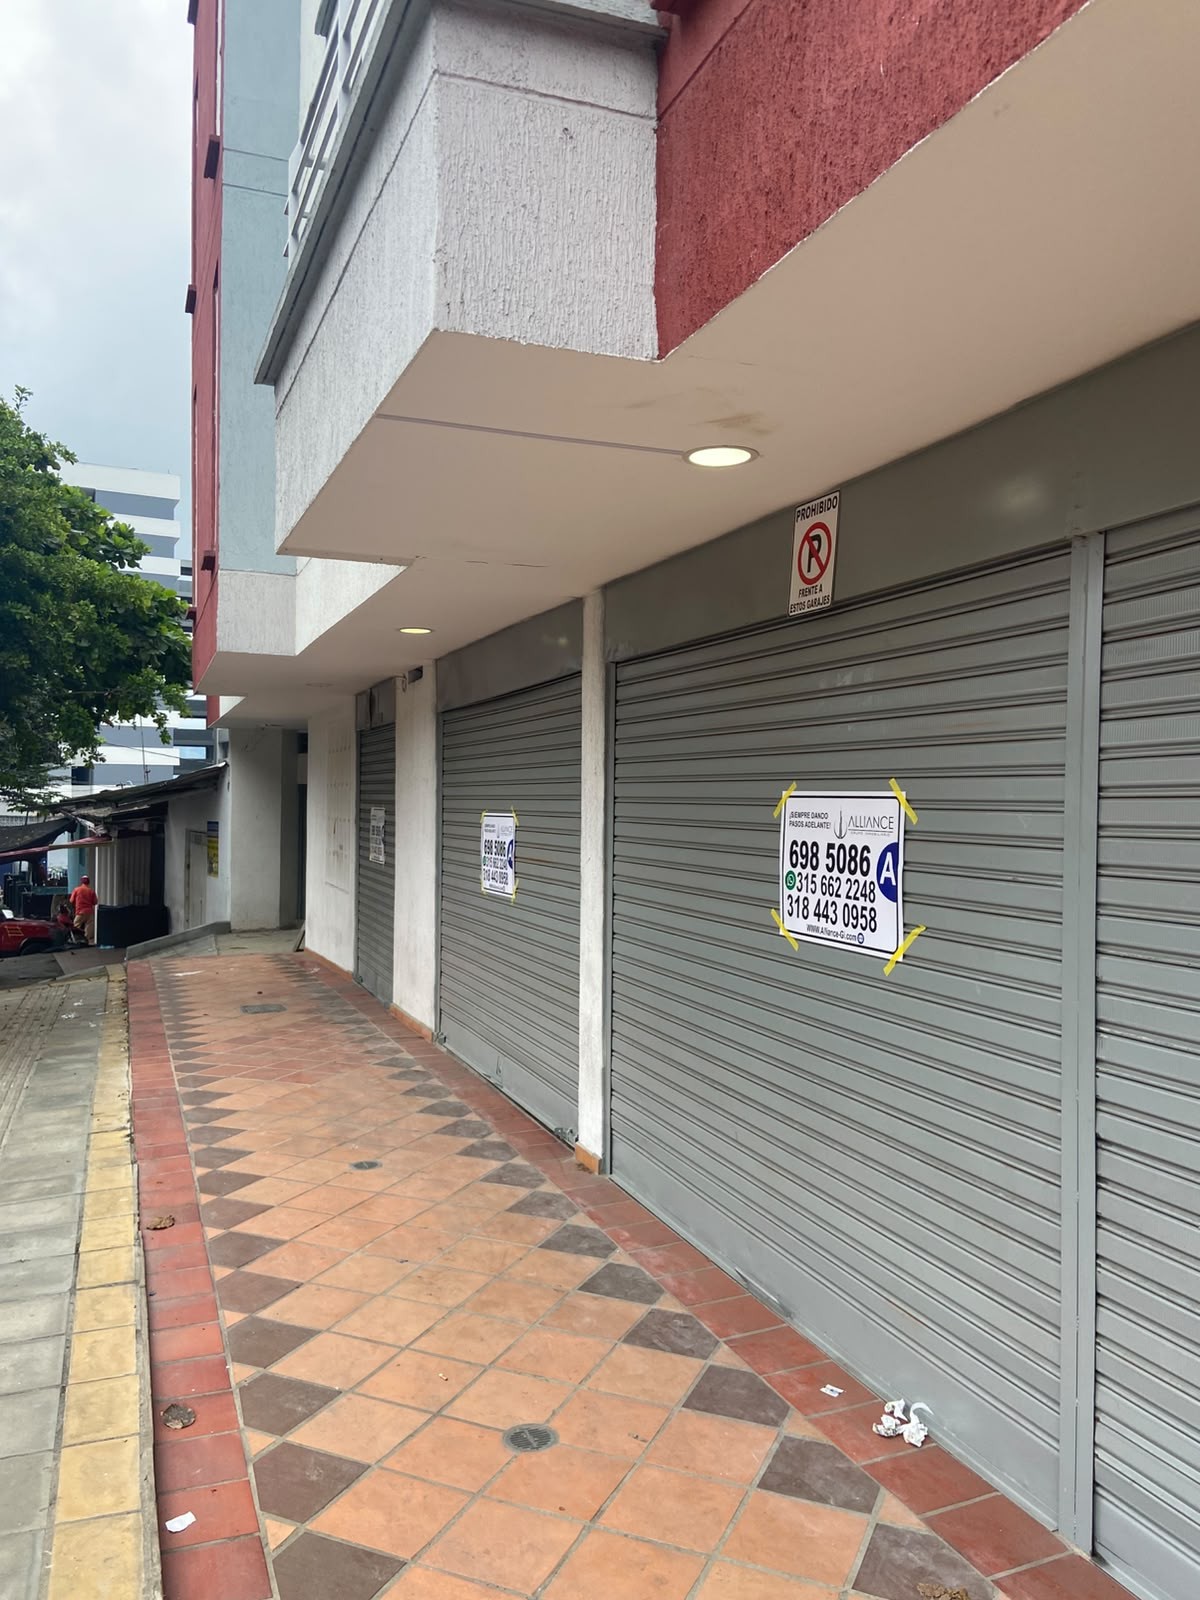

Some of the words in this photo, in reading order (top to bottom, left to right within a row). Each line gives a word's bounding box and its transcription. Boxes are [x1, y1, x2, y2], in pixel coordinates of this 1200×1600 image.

[795, 496, 838, 523] PROHIBIDO
[798, 585, 818, 598] FRENTE
[818, 583, 823, 593] A
[790, 601, 806, 614] ESTOS
[806, 594, 831, 611] GARAJES
[789, 820, 804, 828] PASOS
[811, 812, 828, 820] DANDO
[848, 815, 895, 830] ALLIANCE
[789, 839, 820, 871] 698
[825, 842, 871, 877] 5086
[796, 871, 817, 895] 315
[820, 874, 842, 898] 662
[845, 878, 876, 904] 2248
[787, 894, 809, 920] 318
[813, 898, 838, 925] 443
[842, 902, 877, 933] 0958
